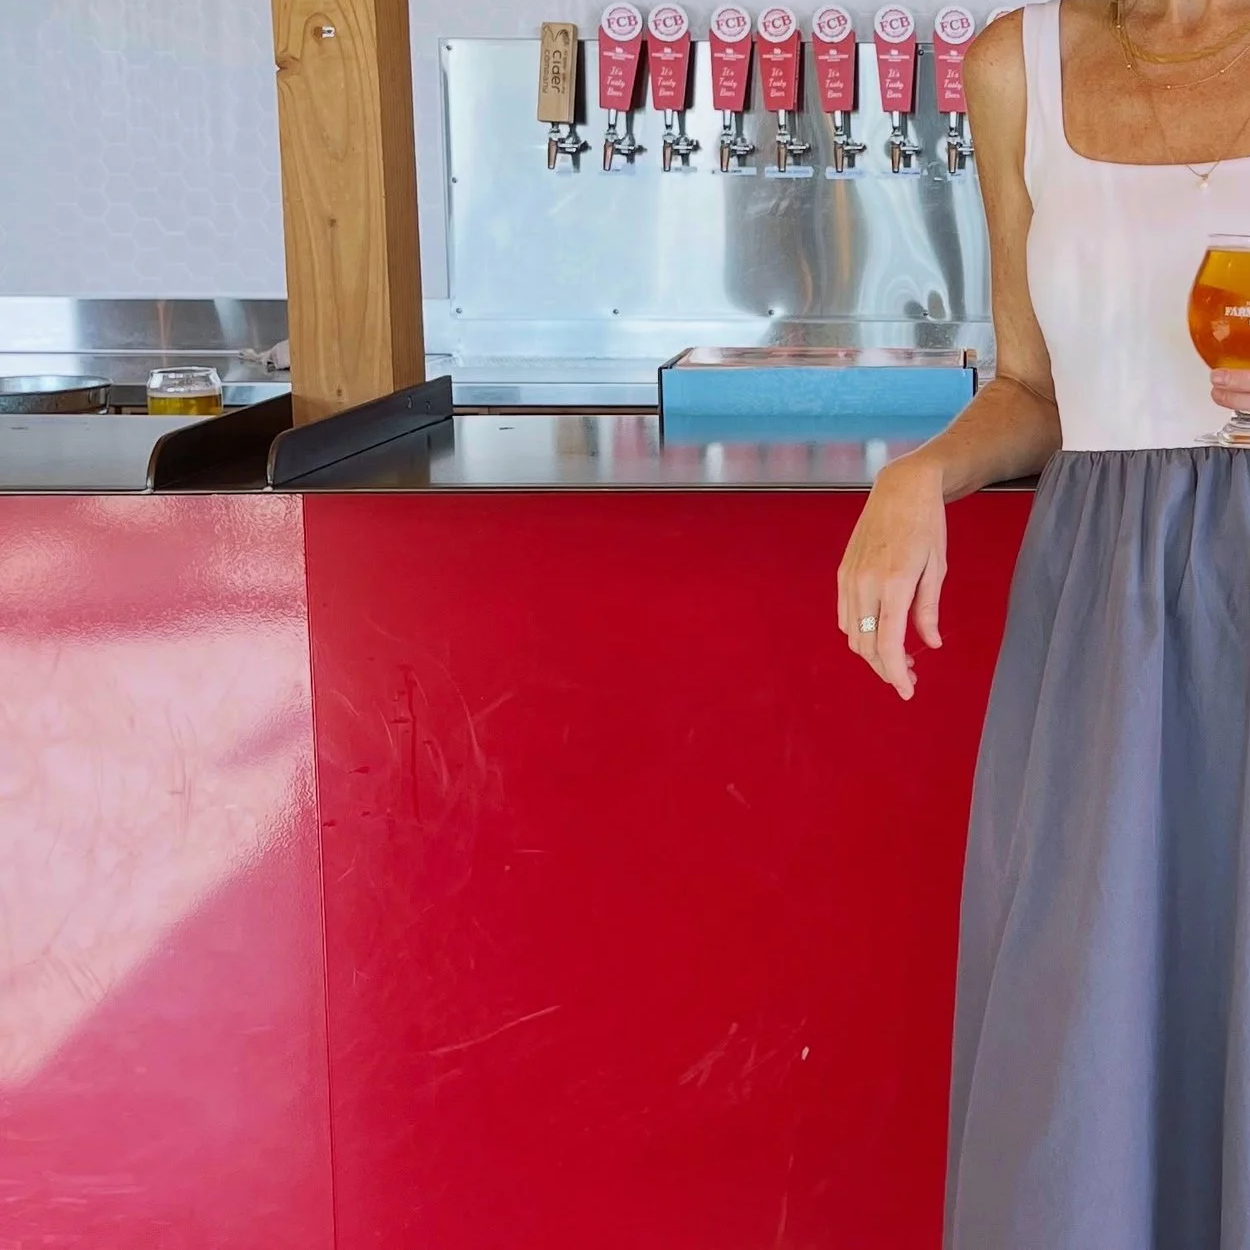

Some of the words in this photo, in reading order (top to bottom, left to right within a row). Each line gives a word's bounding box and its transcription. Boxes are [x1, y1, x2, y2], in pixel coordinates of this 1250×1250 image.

[607, 15, 638, 29] FCB
[653, 14, 684, 31] FCB
[716, 16, 746, 30] FCB
[762, 14, 792, 32] FCB
[817, 14, 847, 33] FCB
[880, 16, 910, 32] FCB
[940, 18, 970, 32] FCB
